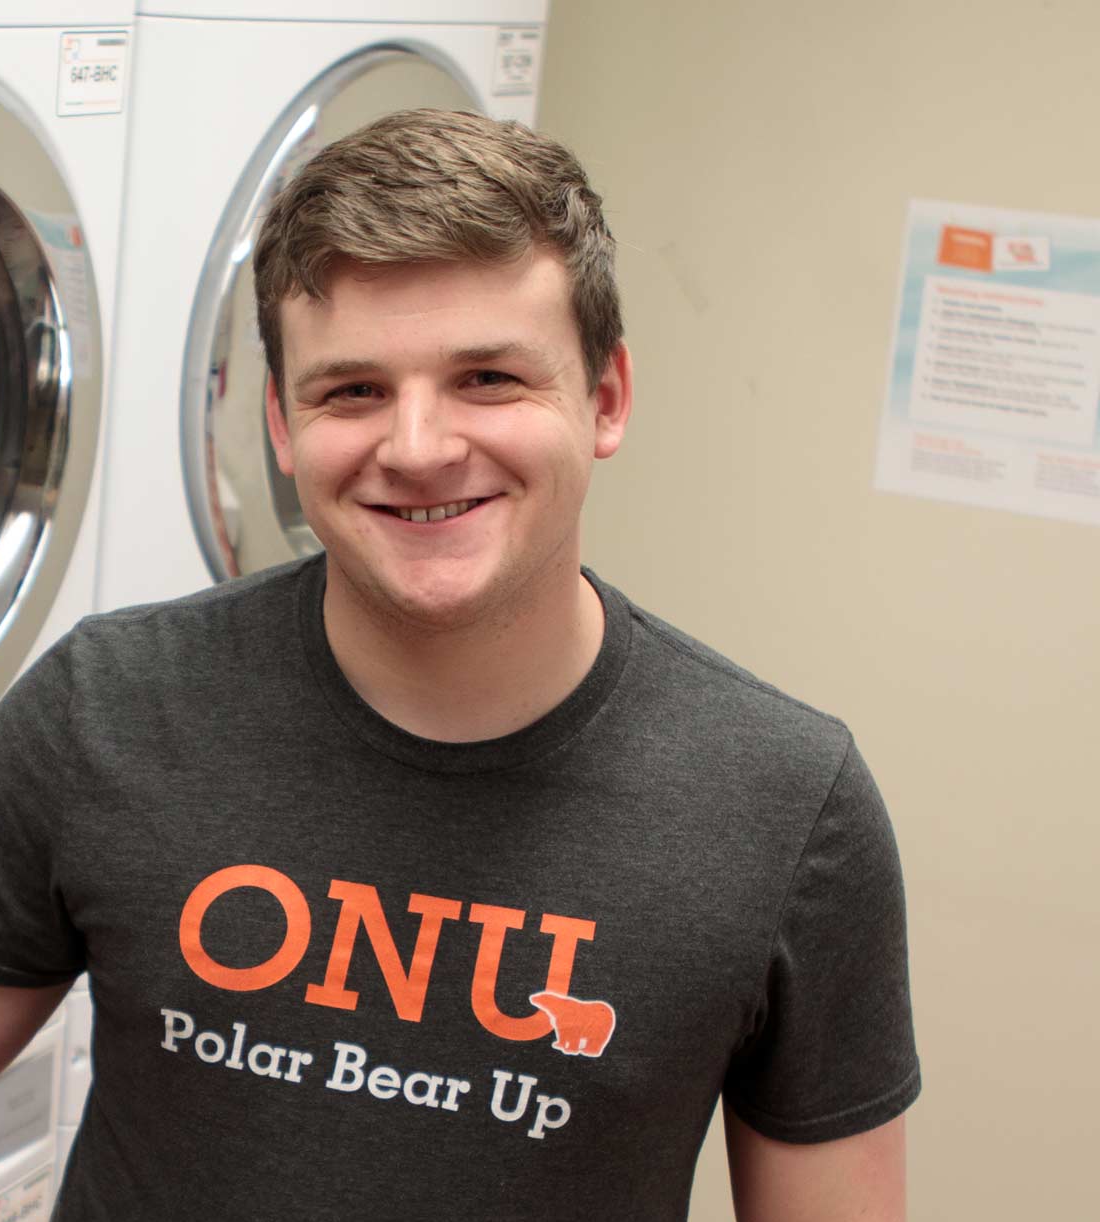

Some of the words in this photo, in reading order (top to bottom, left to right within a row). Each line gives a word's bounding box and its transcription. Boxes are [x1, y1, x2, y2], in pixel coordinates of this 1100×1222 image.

[71, 64, 117, 83] 647-BHC
[179, 864, 597, 1041] ONU
[160, 1008, 314, 1084] Polar
[325, 1042, 471, 1112] Bear
[490, 1069, 571, 1139] Up
